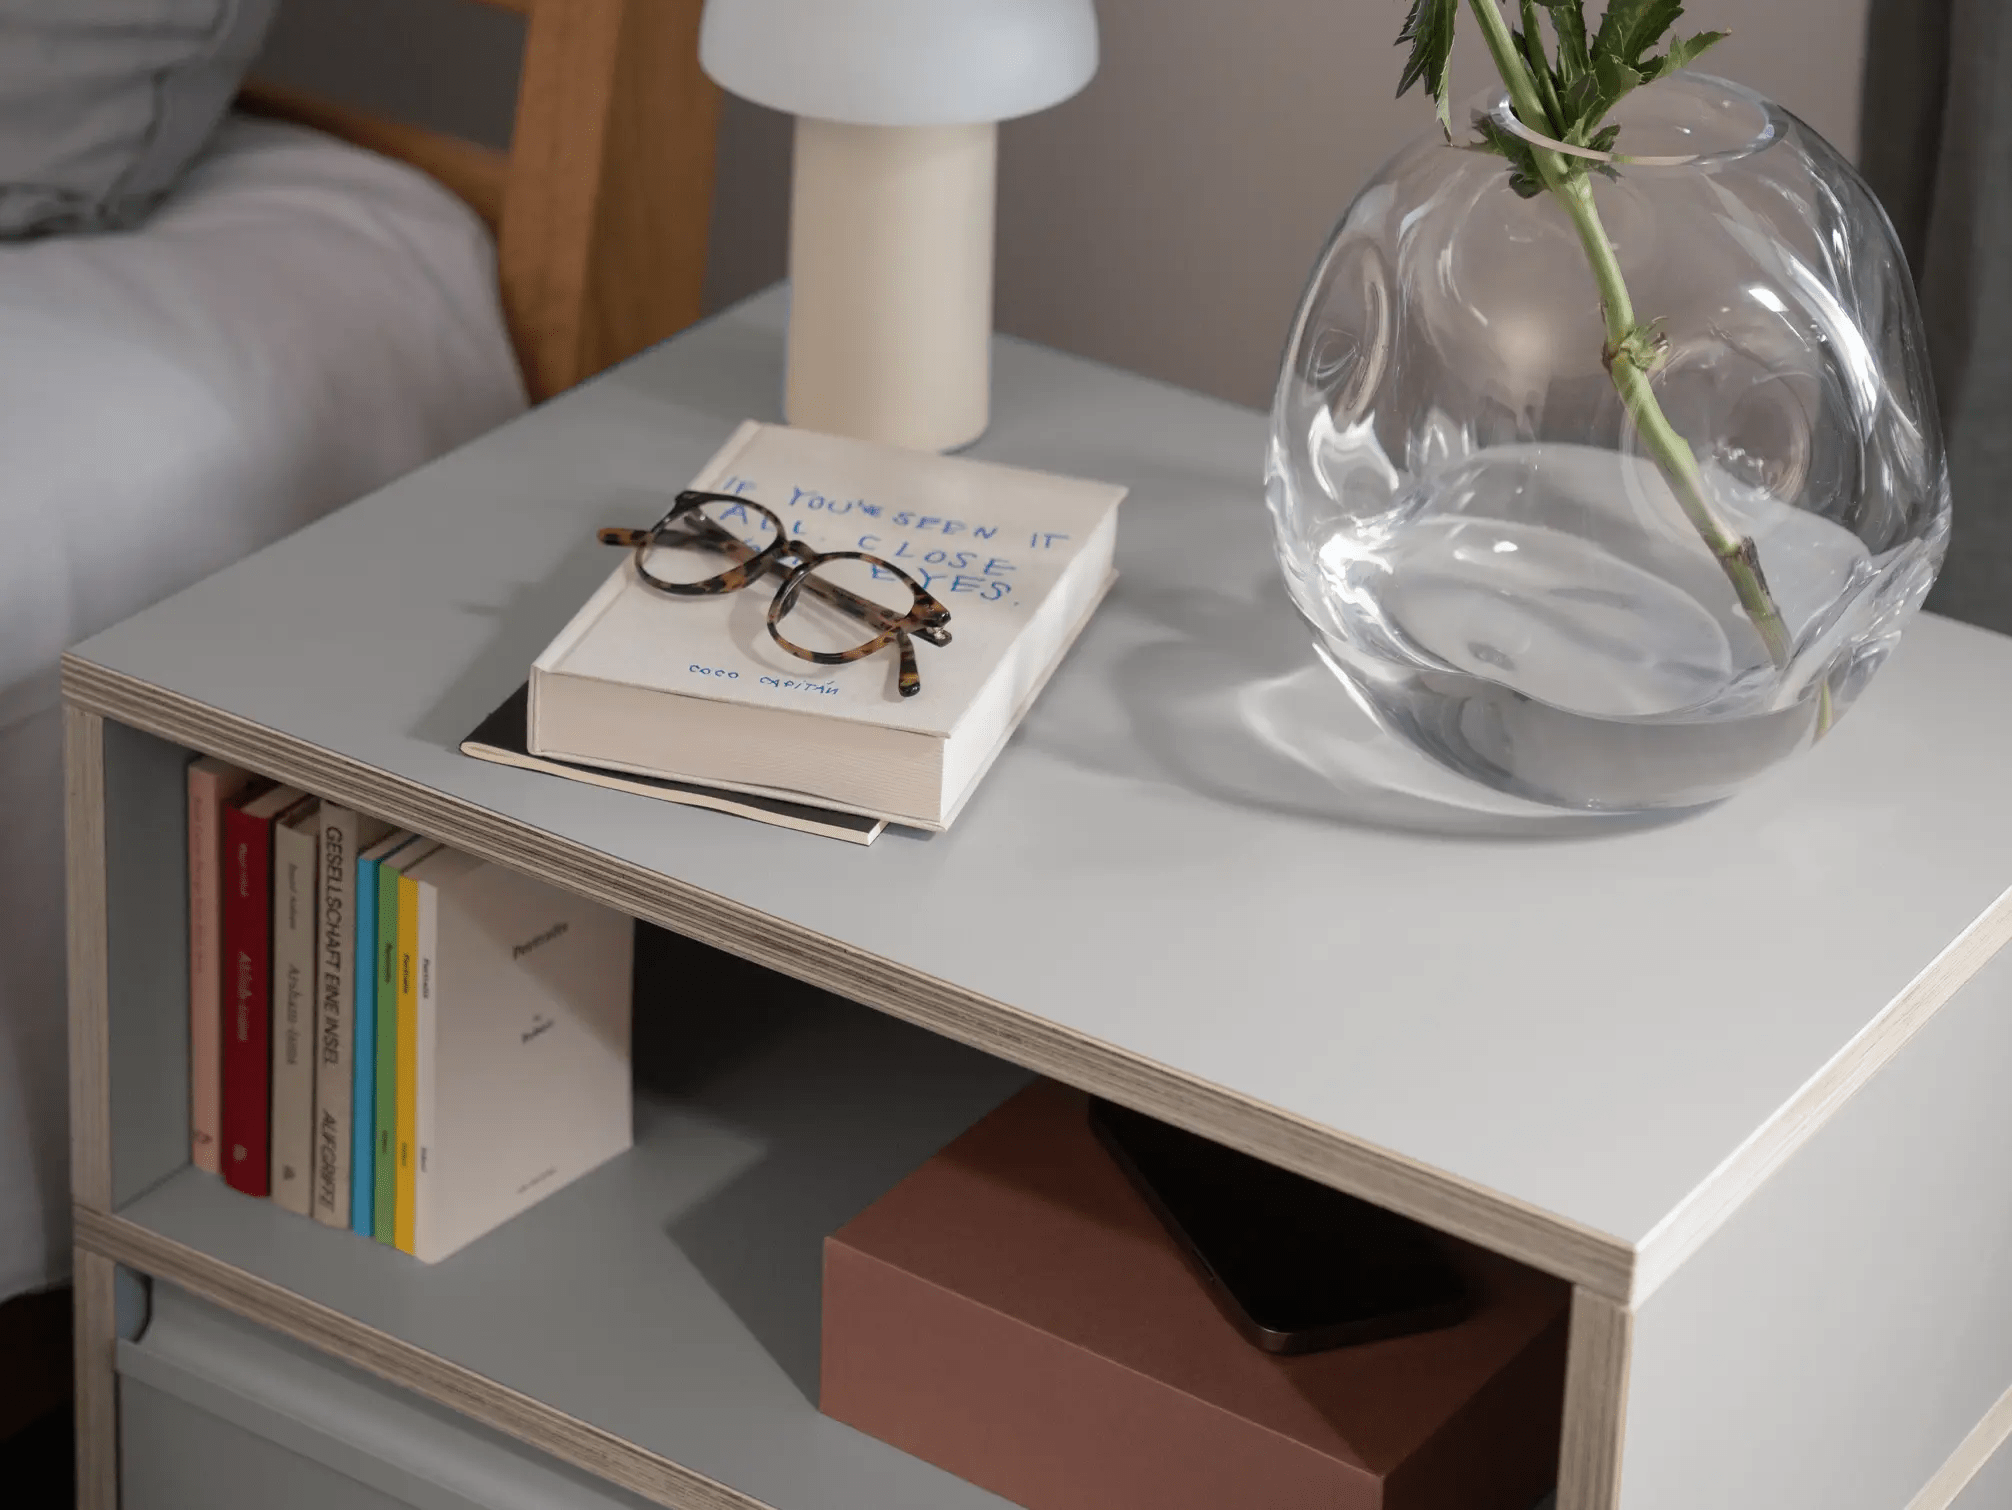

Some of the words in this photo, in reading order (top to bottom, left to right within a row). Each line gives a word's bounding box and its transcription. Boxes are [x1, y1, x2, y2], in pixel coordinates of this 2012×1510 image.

[723, 476, 757, 495] IF
[892, 511, 999, 540] SEEN
[1030, 532, 1071, 550] IT
[857, 534, 1018, 577] CLOSE
[688, 664, 740, 680] COCO
[325, 825, 344, 972] GESELLSCHAFT
[323, 972, 341, 1016] EINE
[322, 1016, 340, 1066] INSEL
